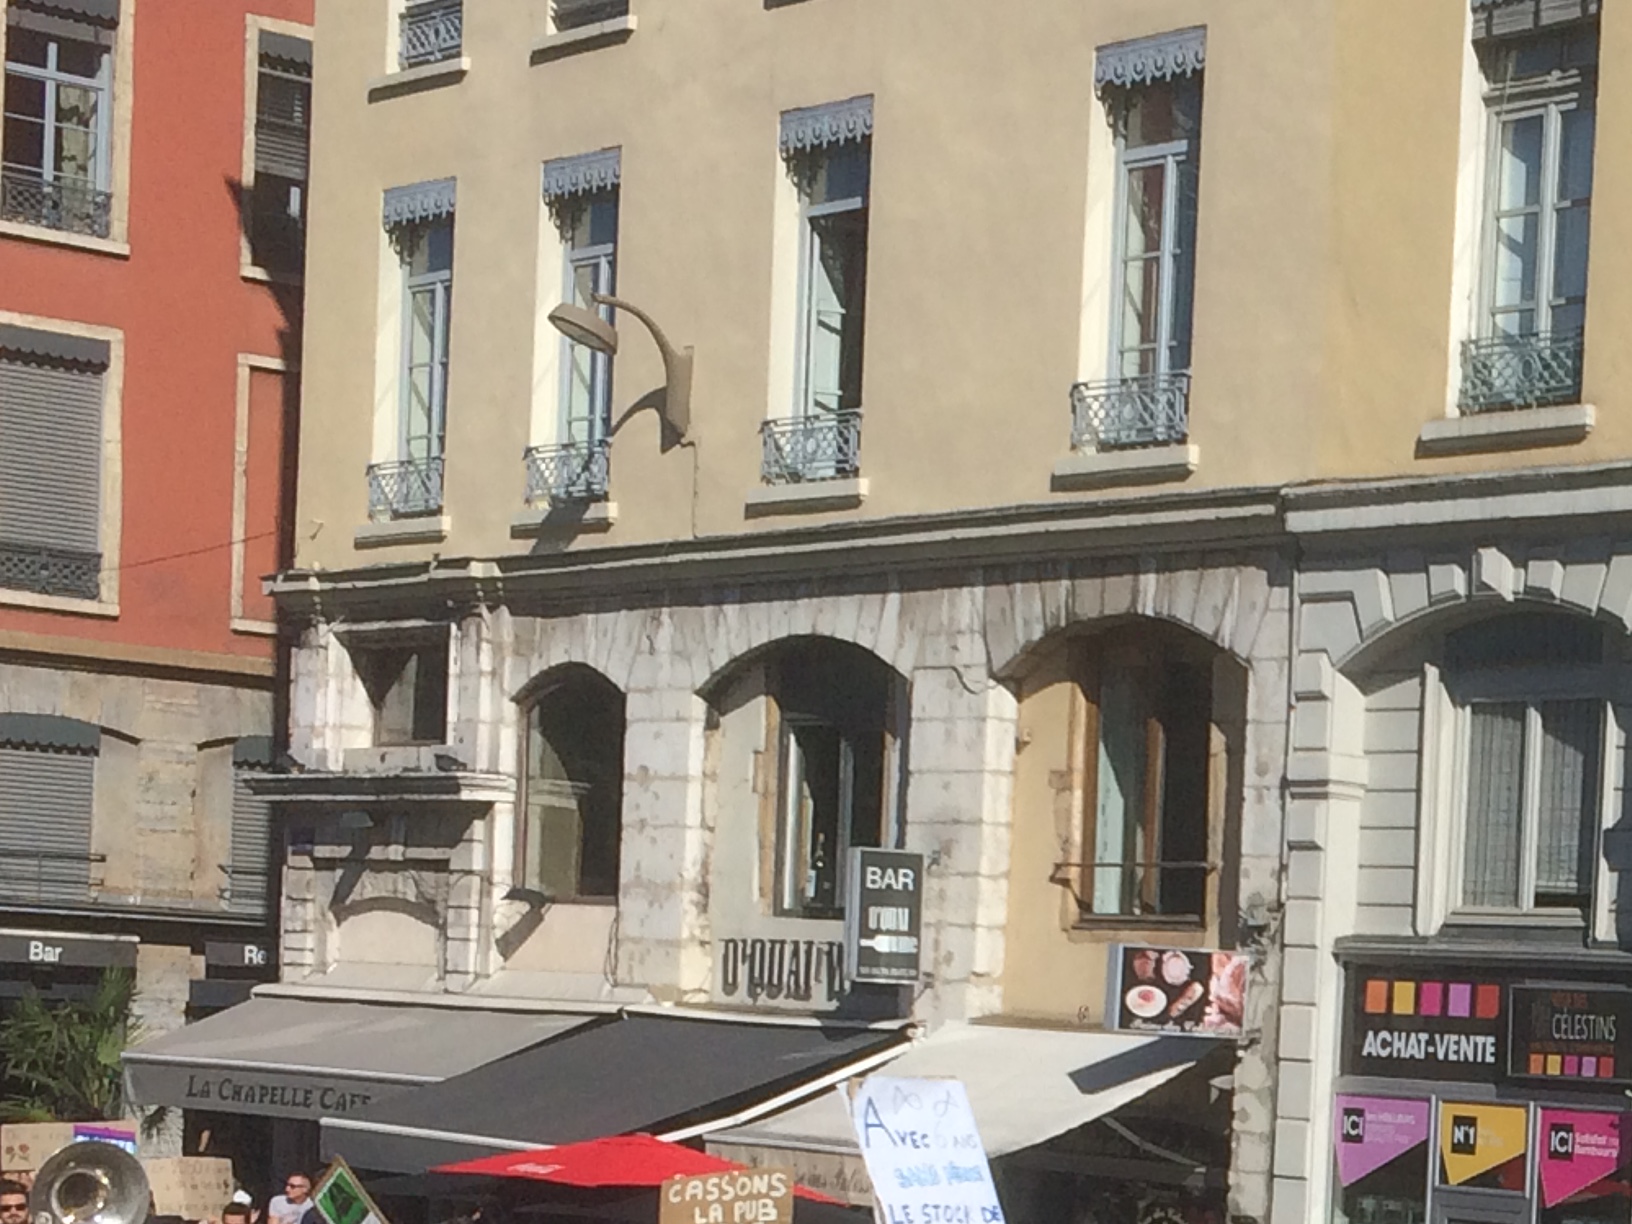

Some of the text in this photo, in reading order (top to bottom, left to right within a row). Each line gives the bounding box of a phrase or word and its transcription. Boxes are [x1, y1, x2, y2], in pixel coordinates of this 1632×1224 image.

[866, 867, 914, 891] BAR
[29, 941, 63, 962] Bar
[1552, 1006, 1617, 1041] CÉLESTINS
[1362, 1030, 1496, 1064] ACHAT-VENTE
[1343, 1115, 1364, 1136] ICI
[1550, 1130, 1573, 1153] ICI
[669, 1173, 787, 1203] CASSONS
[694, 1199, 778, 1224] LA PUB
